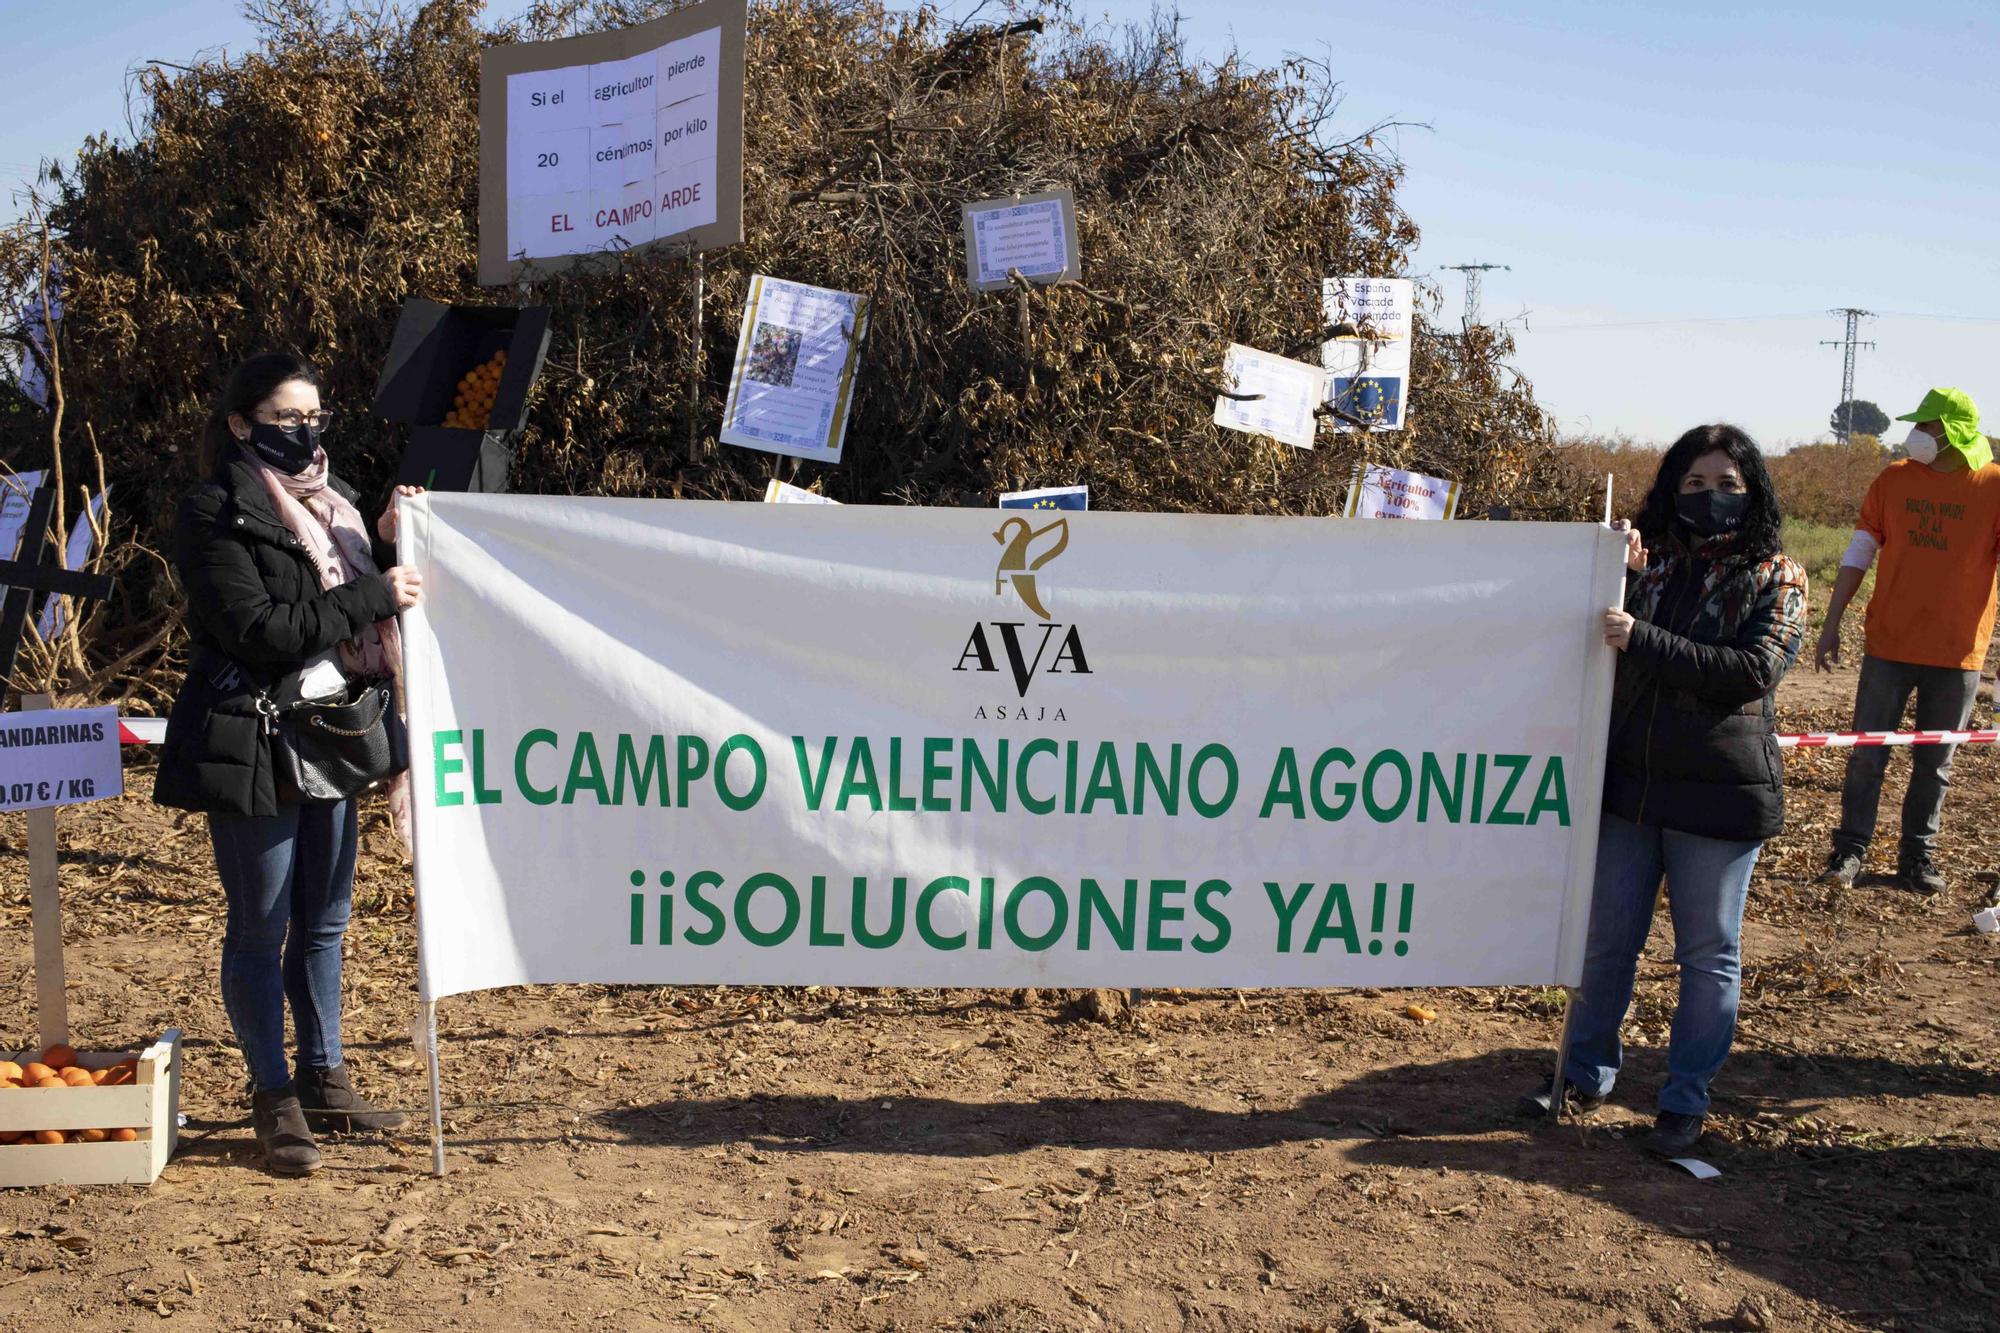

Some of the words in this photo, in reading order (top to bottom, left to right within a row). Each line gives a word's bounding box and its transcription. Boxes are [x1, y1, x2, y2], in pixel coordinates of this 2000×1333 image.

[531, 92, 547, 106] Si
[551, 90, 564, 104] el
[594, 74, 654, 100] agricultor
[667, 55, 705, 80] pierde
[537, 153, 559, 167] 20
[596, 139, 653, 162] céntimos
[664, 126, 683, 145] por
[685, 118, 708, 137] kilo
[551, 214, 574, 232] EL
[595, 200, 653, 228] CAMPO
[661, 183, 702, 212] ARDE
[1355, 283, 1391, 294] España
[1377, 475, 1435, 498] Agricultor
[952, 621, 1093, 698] AVA
[974, 706, 1067, 722] ASAJA
[69, 778, 95, 798] KG
[432, 728, 502, 807] EL
[514, 728, 768, 811] CAMPO
[791, 735, 1239, 819] VALENCIANO
[1258, 747, 1572, 827] AGONIZA
[630, 869, 1233, 954] ¡¡SOLUCIONES
[1262, 882, 1415, 957] YA!!
